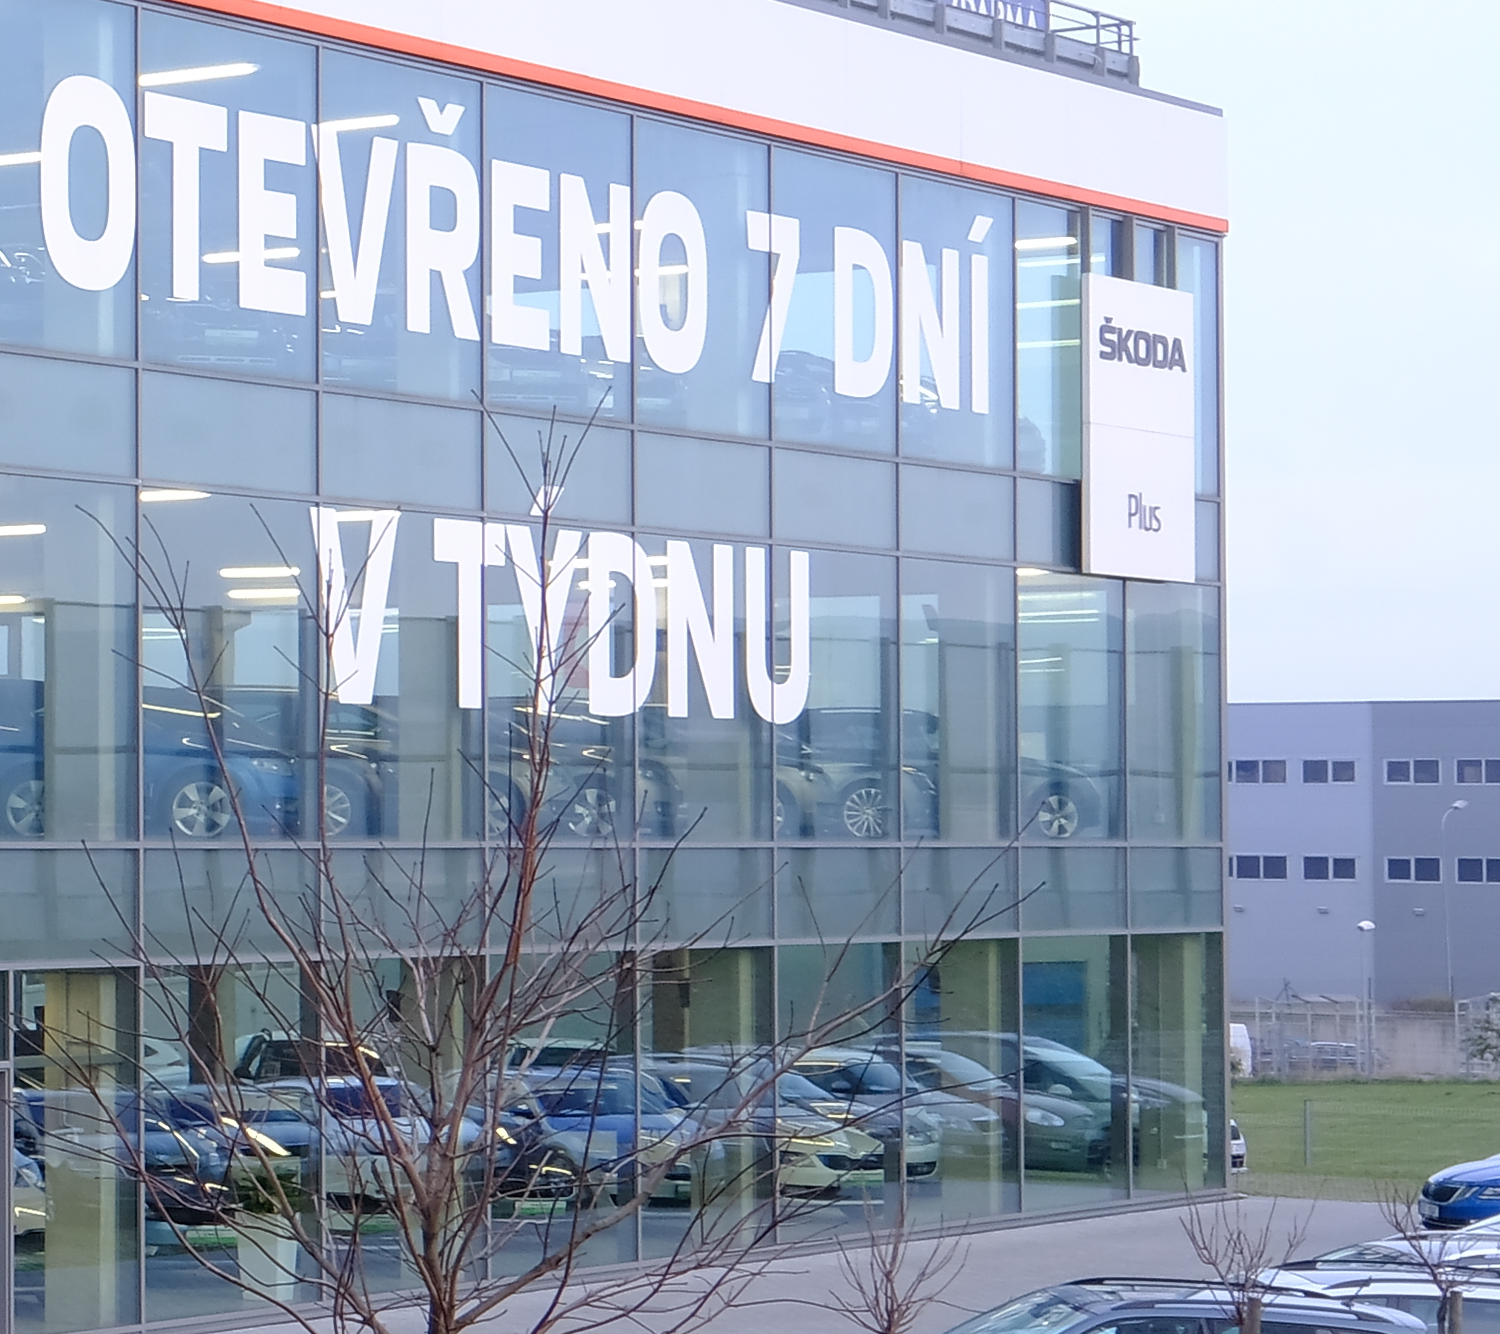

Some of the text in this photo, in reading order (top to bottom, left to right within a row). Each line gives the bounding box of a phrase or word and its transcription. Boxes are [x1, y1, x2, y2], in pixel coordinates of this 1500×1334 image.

[40, 73, 994, 416] OTEVŘENO 7 DNÍ
[1098, 316, 1188, 373] ŠKODA
[1127, 492, 1162, 533] Plus
[310, 484, 812, 725] V TÝDNU
